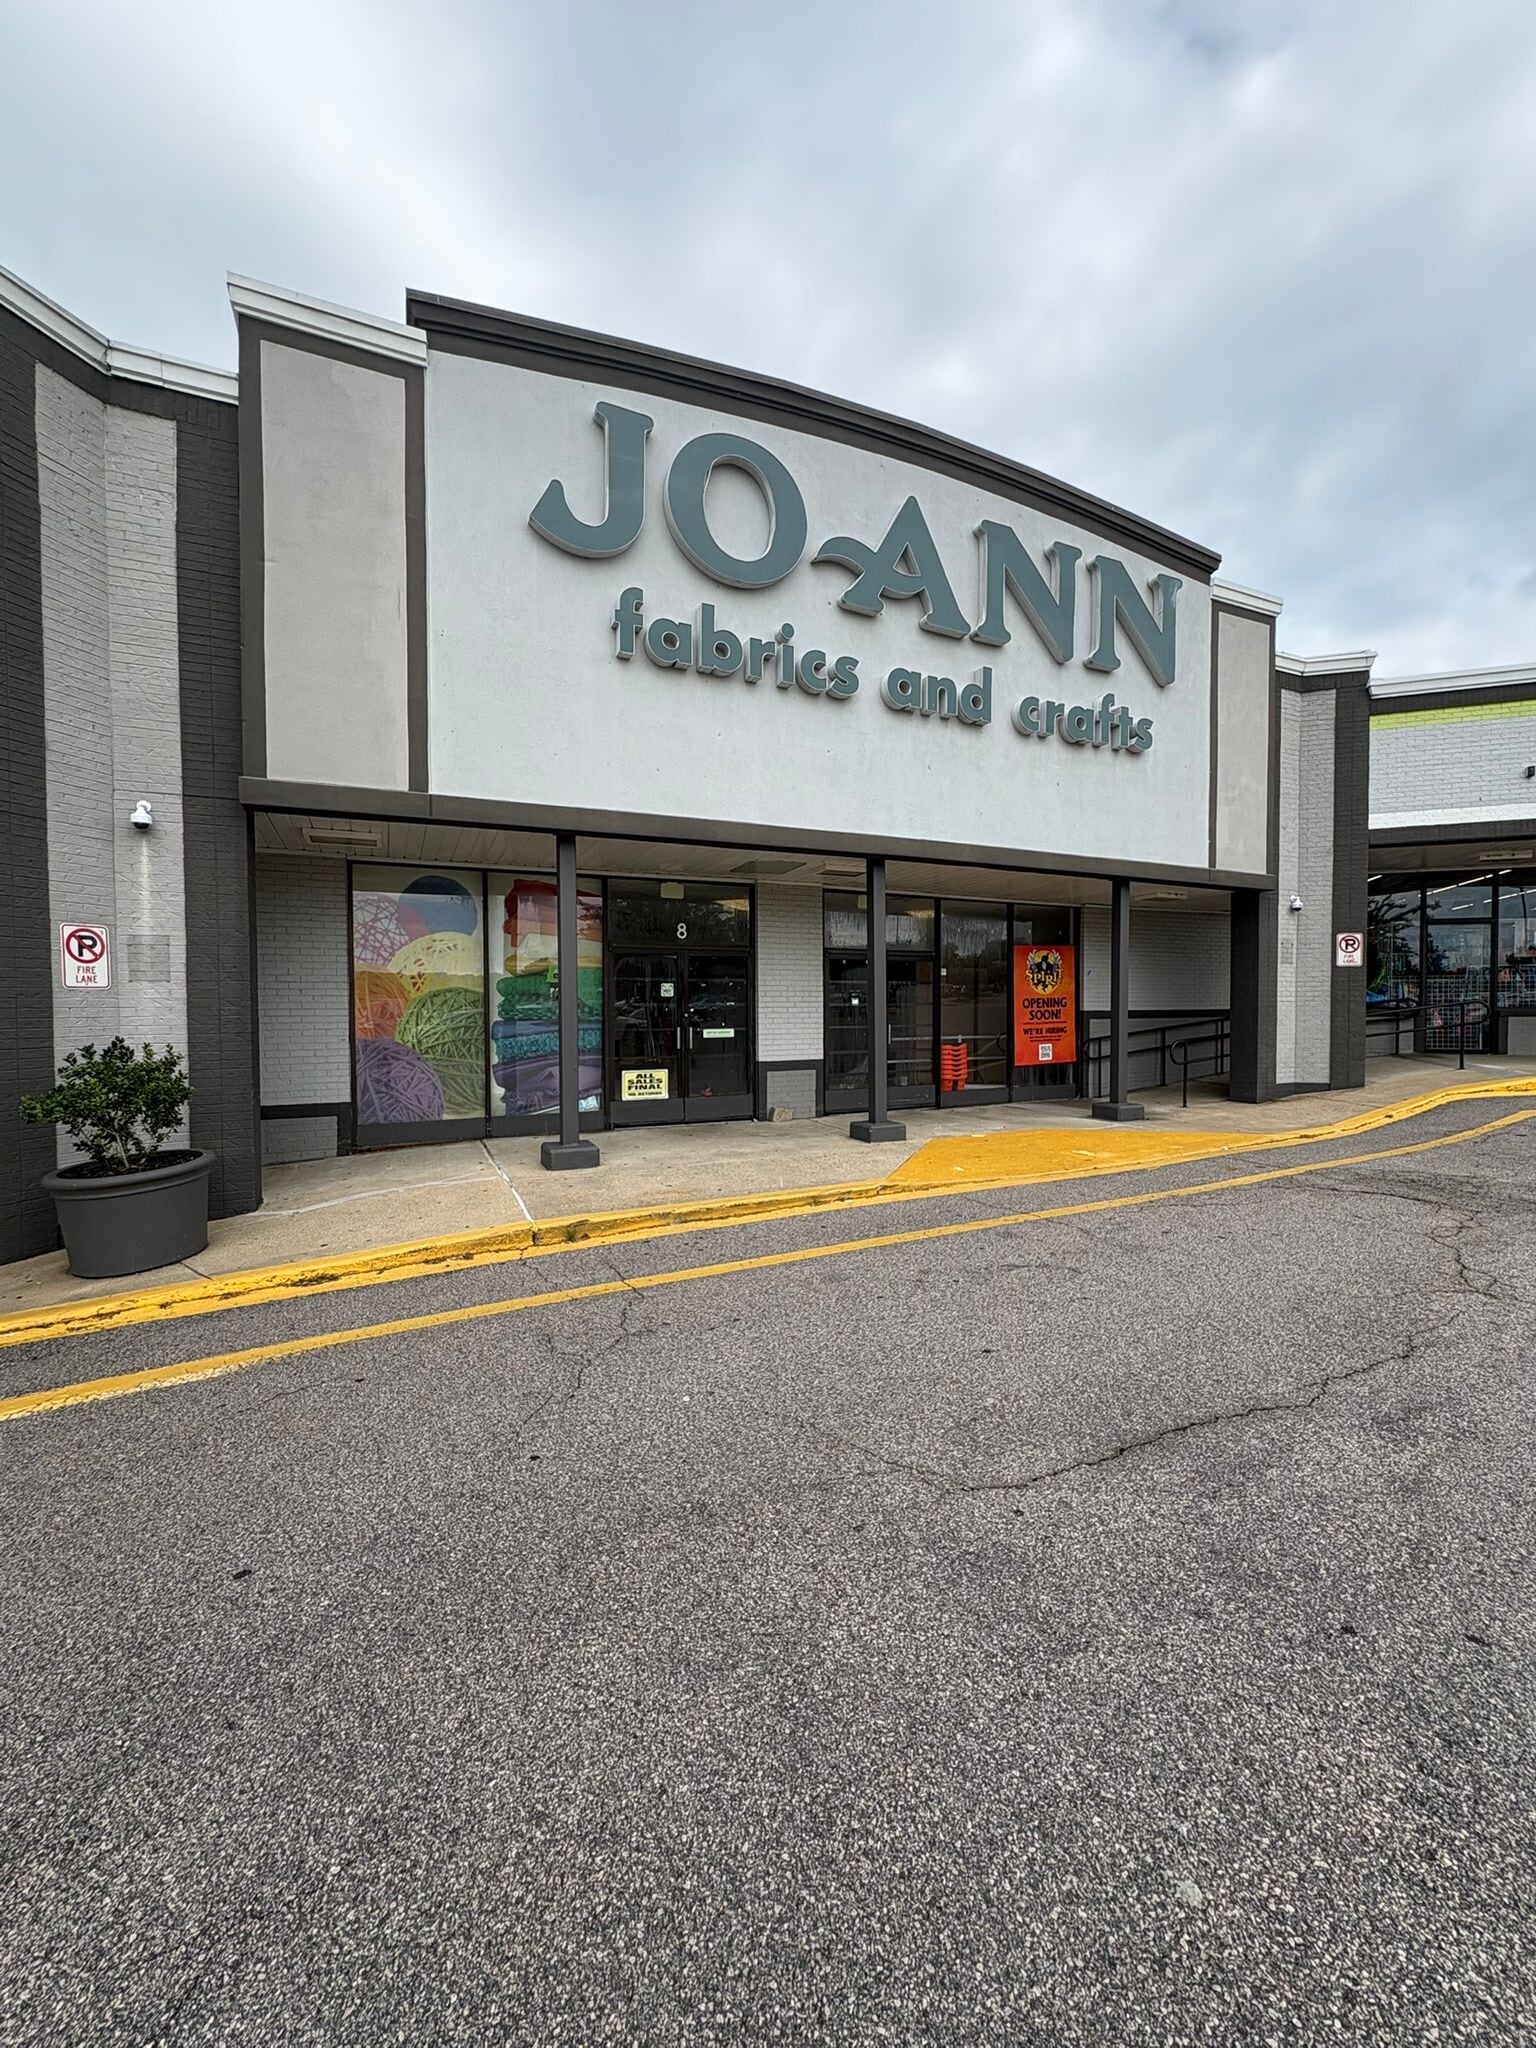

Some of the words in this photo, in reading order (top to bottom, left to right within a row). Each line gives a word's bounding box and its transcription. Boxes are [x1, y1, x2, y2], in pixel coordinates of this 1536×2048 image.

[611, 587, 861, 700] fabrics
[881, 666, 993, 726] and
[1012, 692, 1154, 754] crafts
[677, 923, 687, 939] 8
[77, 965, 97, 975] FIRE
[76, 975, 98, 984] LANE
[1026, 968, 1063, 985] SPIRIT
[1022, 997, 1067, 1008] OPENING
[1029, 1009, 1061, 1020] SOON!
[1046, 1026, 1067, 1034] HIRING
